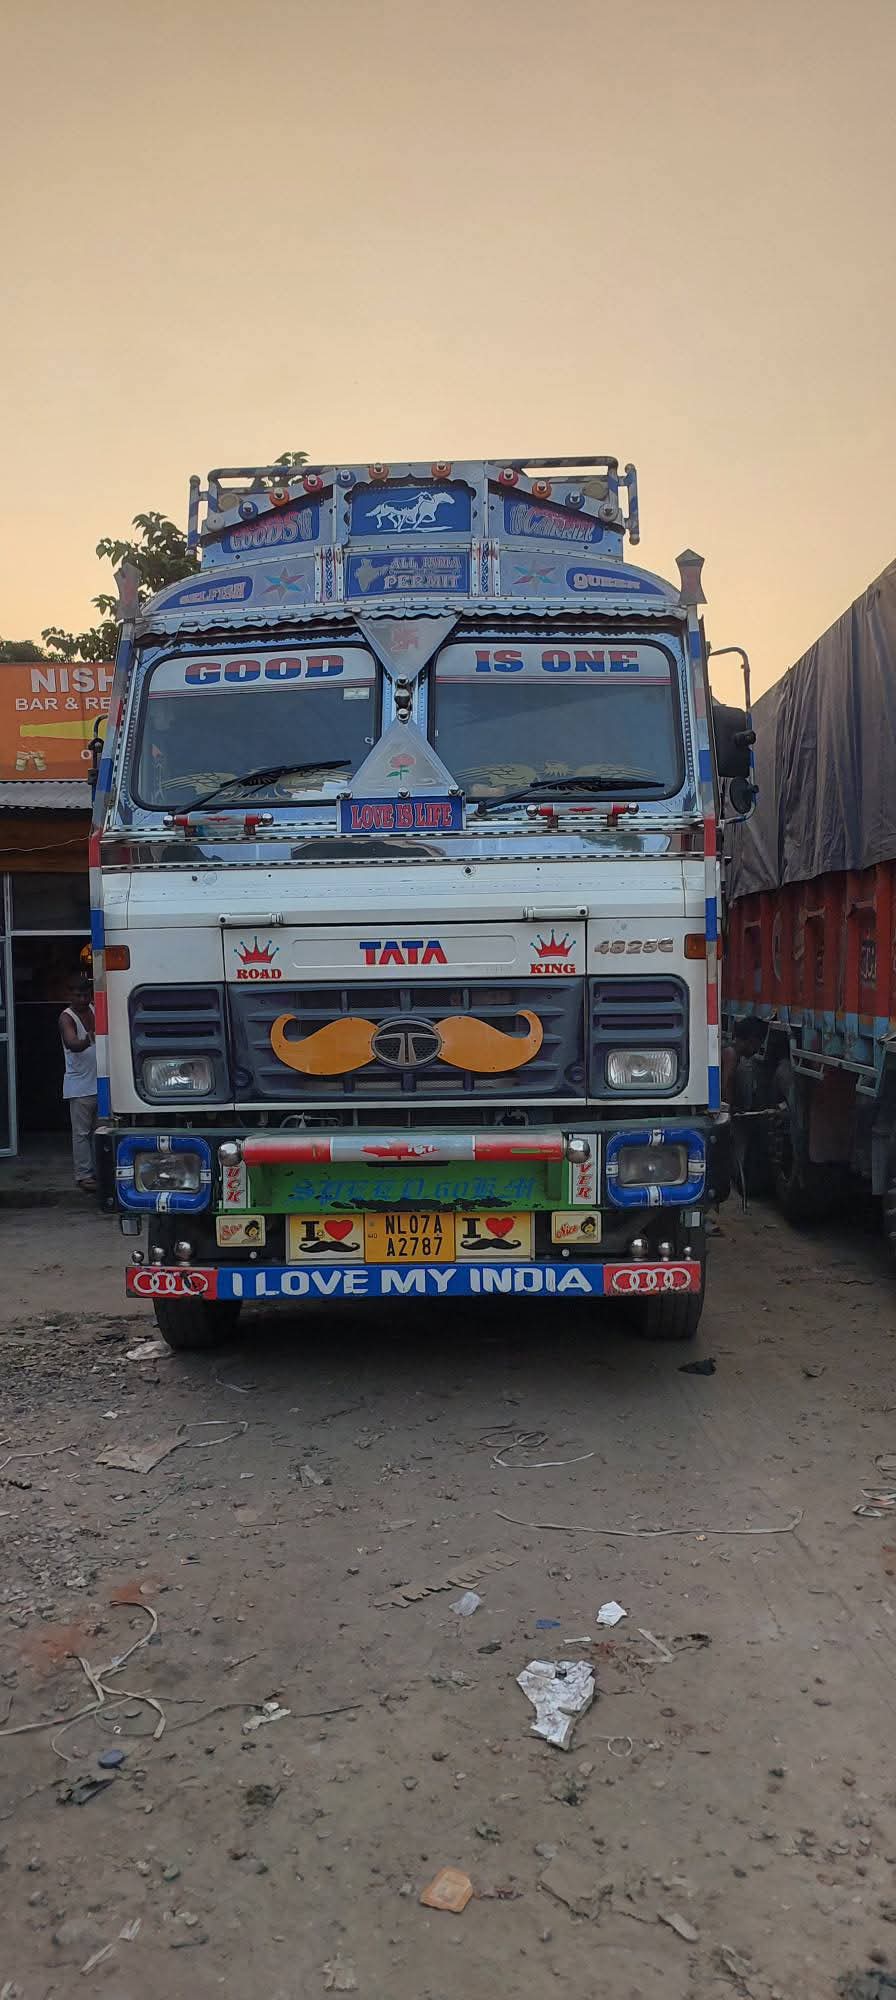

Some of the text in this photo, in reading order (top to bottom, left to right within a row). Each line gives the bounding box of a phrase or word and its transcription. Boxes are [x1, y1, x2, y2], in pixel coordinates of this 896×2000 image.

[390, 557, 418, 569] ALL
[384, 575, 460, 589] PERMIT
[184, 654, 344, 686] GOOD
[475, 650, 640, 673] IS ONE
[15, 697, 59, 711] BAR
[64, 697, 80, 710] &
[351, 802, 452, 829] LOVE IS LIFE
[359, 940, 448, 965] TATA
[594, 936, 674, 955] 4825C
[236, 968, 282, 979] ROAD
[530, 963, 577, 974] KING
[385, 1215, 443, 1235] NL07A
[386, 1237, 443, 1257] A2787
[232, 1267, 592, 1296] I LOVE MY INDIA
